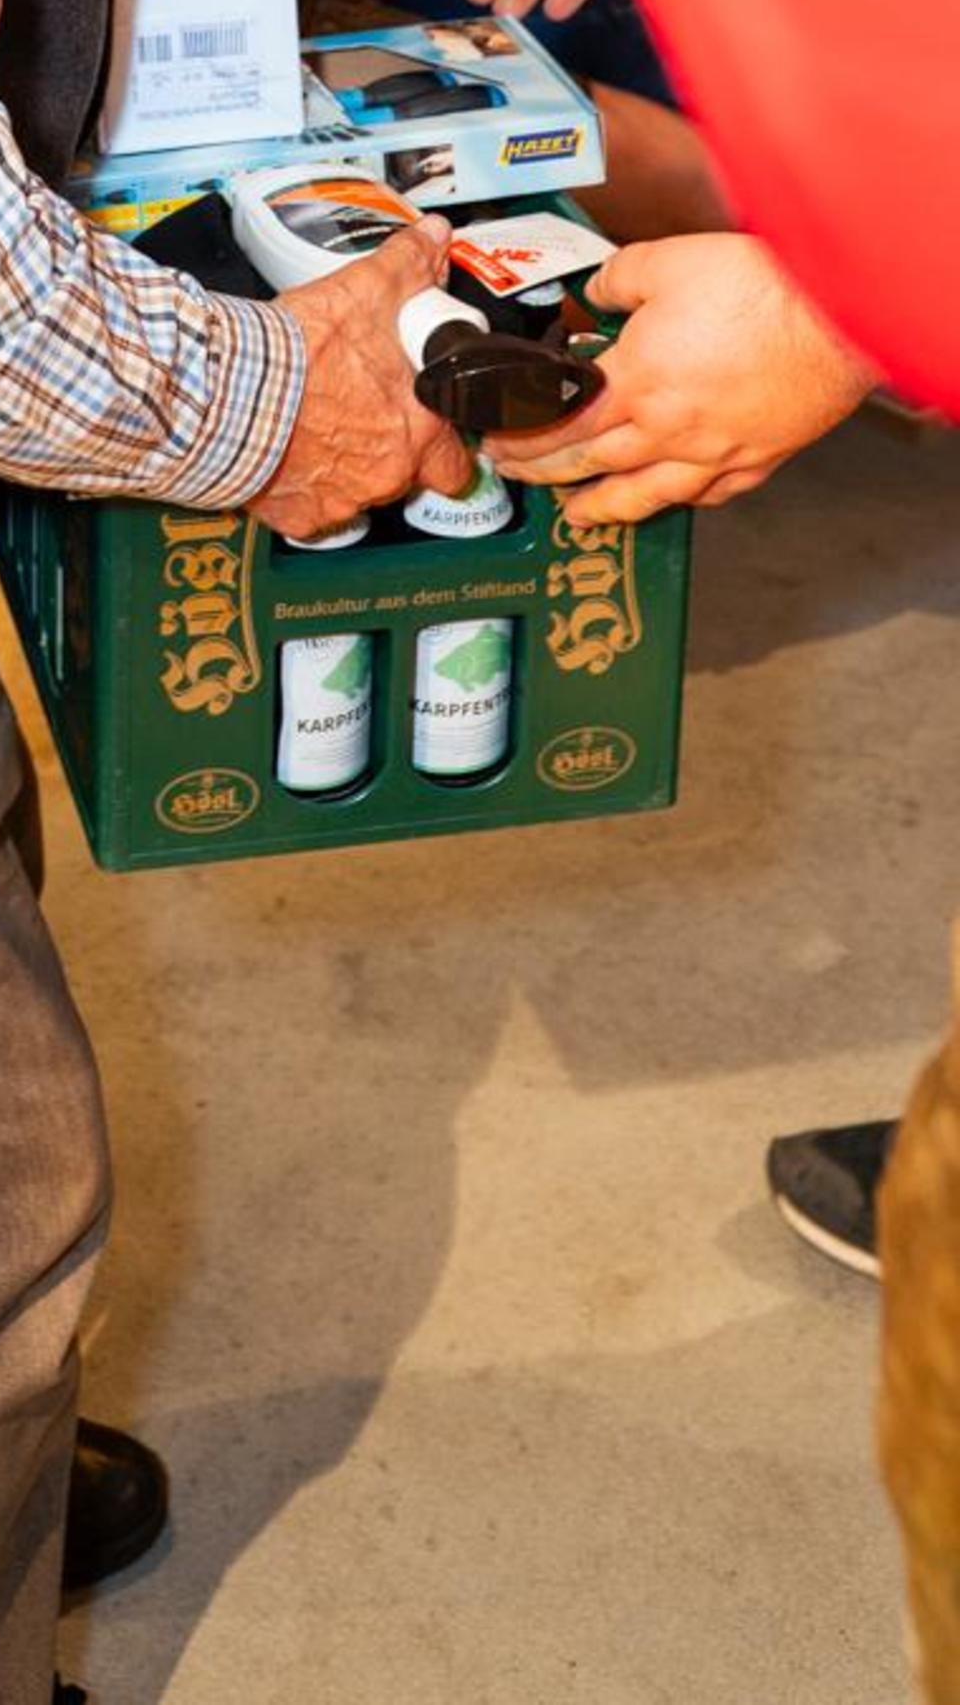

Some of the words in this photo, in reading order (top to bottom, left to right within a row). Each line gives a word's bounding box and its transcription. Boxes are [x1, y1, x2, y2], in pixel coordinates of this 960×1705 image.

[274, 597, 370, 620] Braukultur
[374, 596, 408, 610] aus
[412, 588, 456, 606] dem
[461, 578, 537, 601] Stiftland
